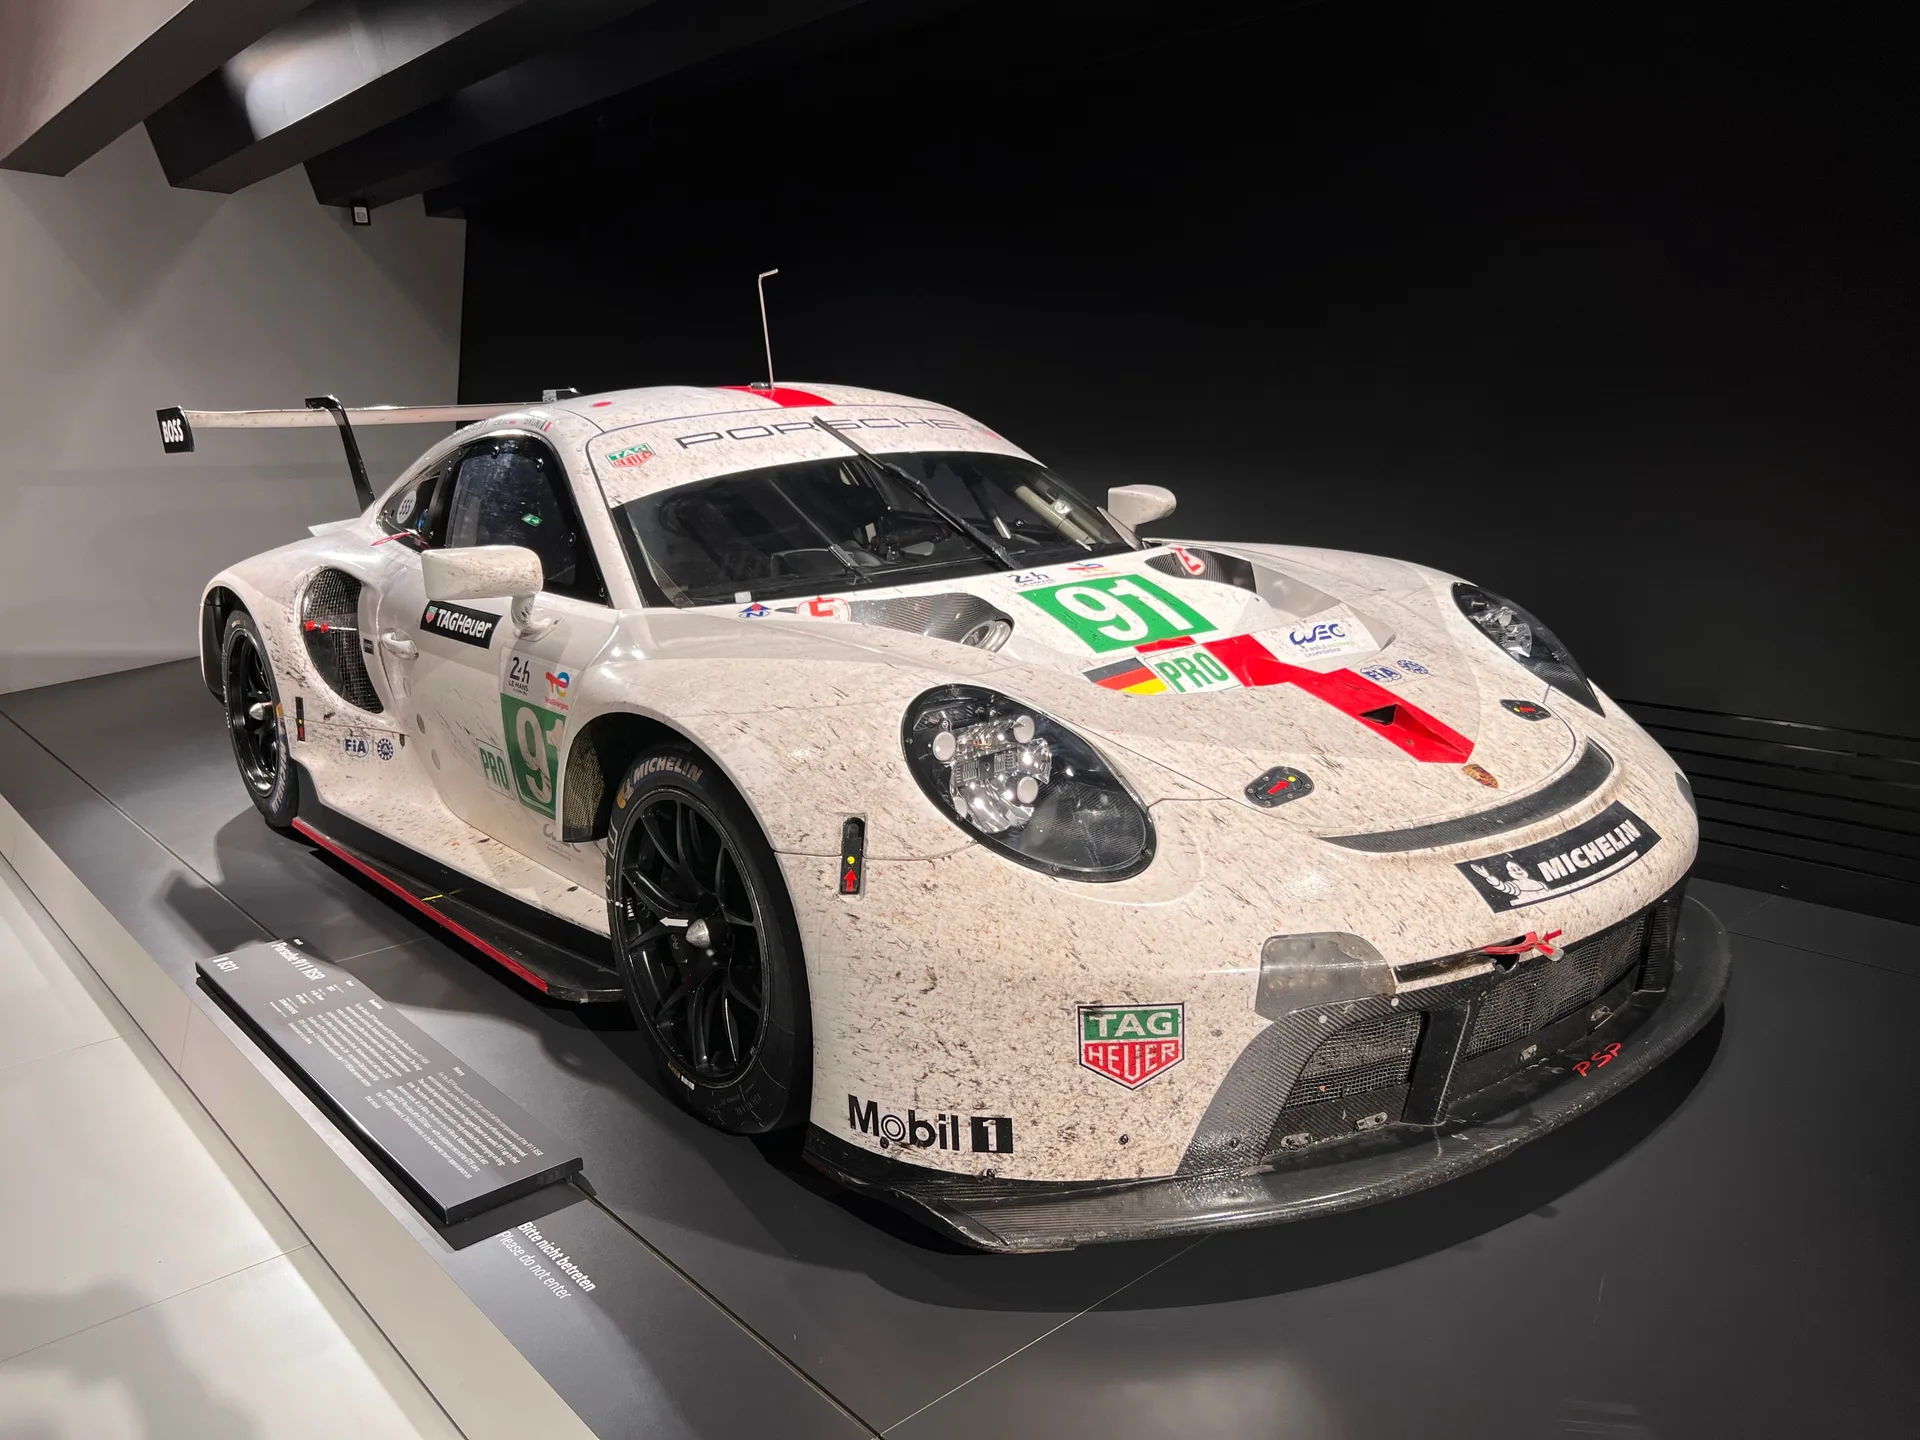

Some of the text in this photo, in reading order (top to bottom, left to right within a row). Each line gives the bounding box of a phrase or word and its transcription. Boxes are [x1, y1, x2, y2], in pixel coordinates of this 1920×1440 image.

[162, 418, 184, 443] BOSS
[675, 418, 970, 449] PORSCHE
[437, 608, 493, 639] TAGHeuer
[1055, 578, 1193, 641] 91
[1289, 623, 1346, 646] WEC
[510, 656, 531, 685] 24h
[1154, 652, 1229, 693] PRO
[479, 747, 510, 791] PRO
[633, 756, 704, 785] MICHELIN
[1537, 819, 1641, 882] MICHELIN
[271, 942, 326, 981] Porsche 911 RSR
[1088, 1012, 1173, 1037] TAG
[1087, 1043, 1176, 1081] HEUER
[1573, 1042, 1622, 1077] PSP
[848, 1094, 960, 1151] Mobil
[496, 1230, 571, 1299] Please do not enter
[517, 1221, 596, 1292] Bitte nicht betreten
